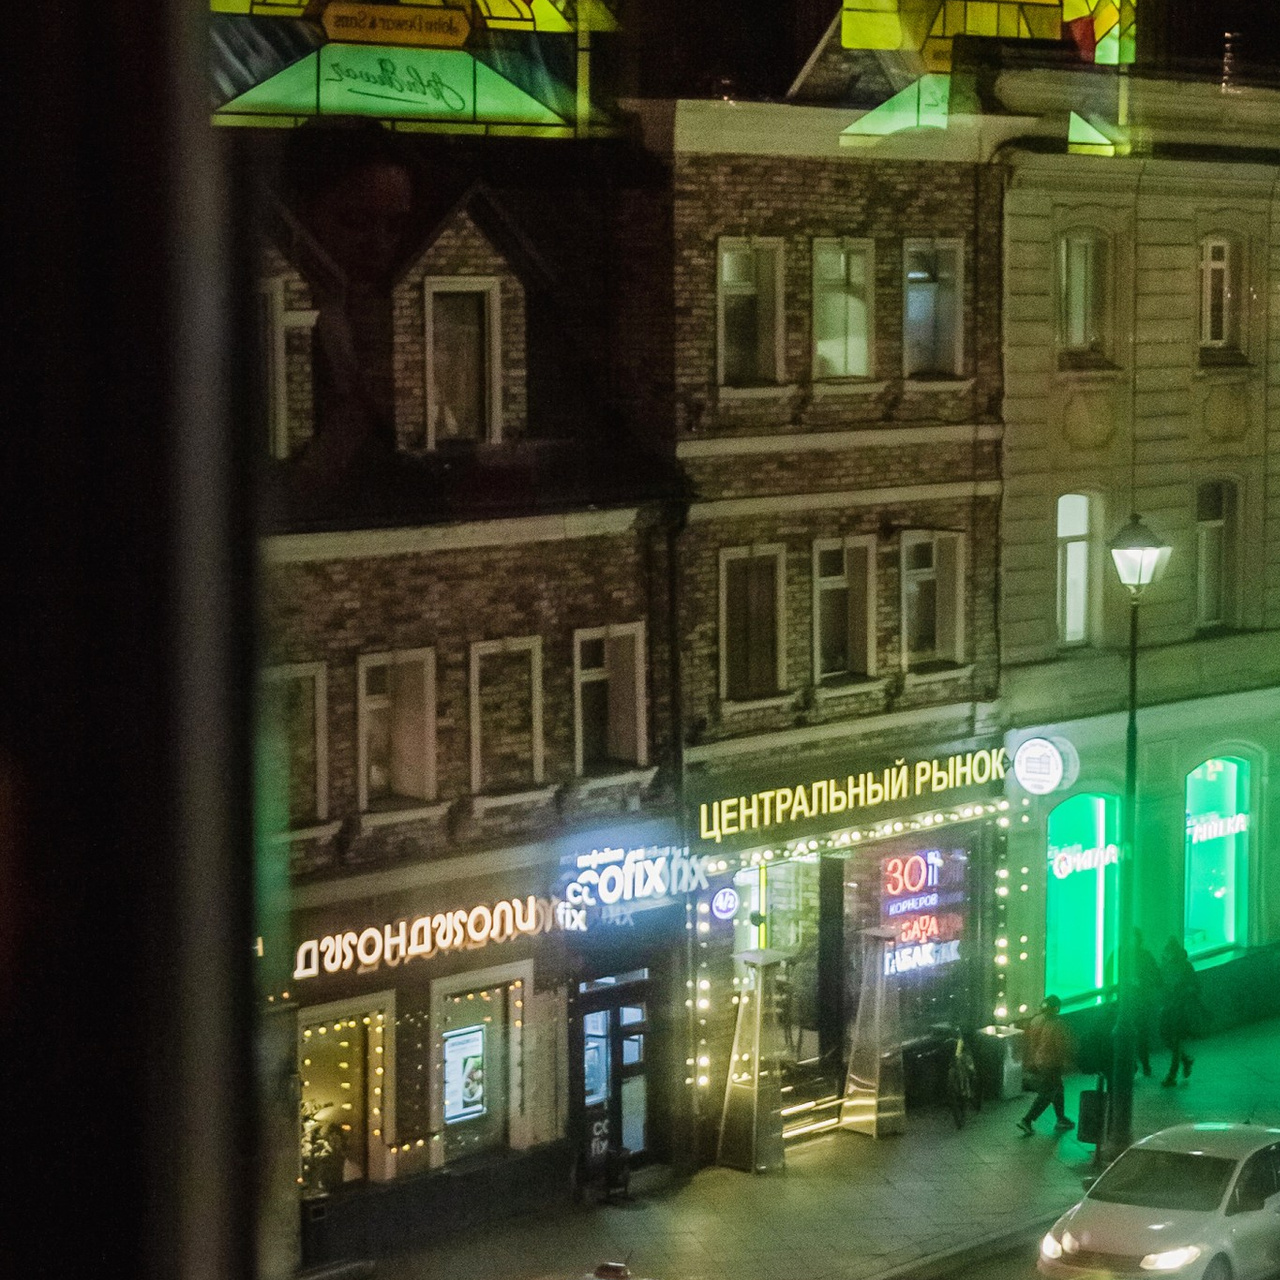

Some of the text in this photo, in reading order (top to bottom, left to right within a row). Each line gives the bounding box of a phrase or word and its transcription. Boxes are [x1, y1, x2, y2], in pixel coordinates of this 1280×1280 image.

[700, 759, 909, 842] ЦЕНТРАЛЬНЫЙ
[914, 747, 1006, 792] РЫНОК
[885, 855, 927, 896] 30
